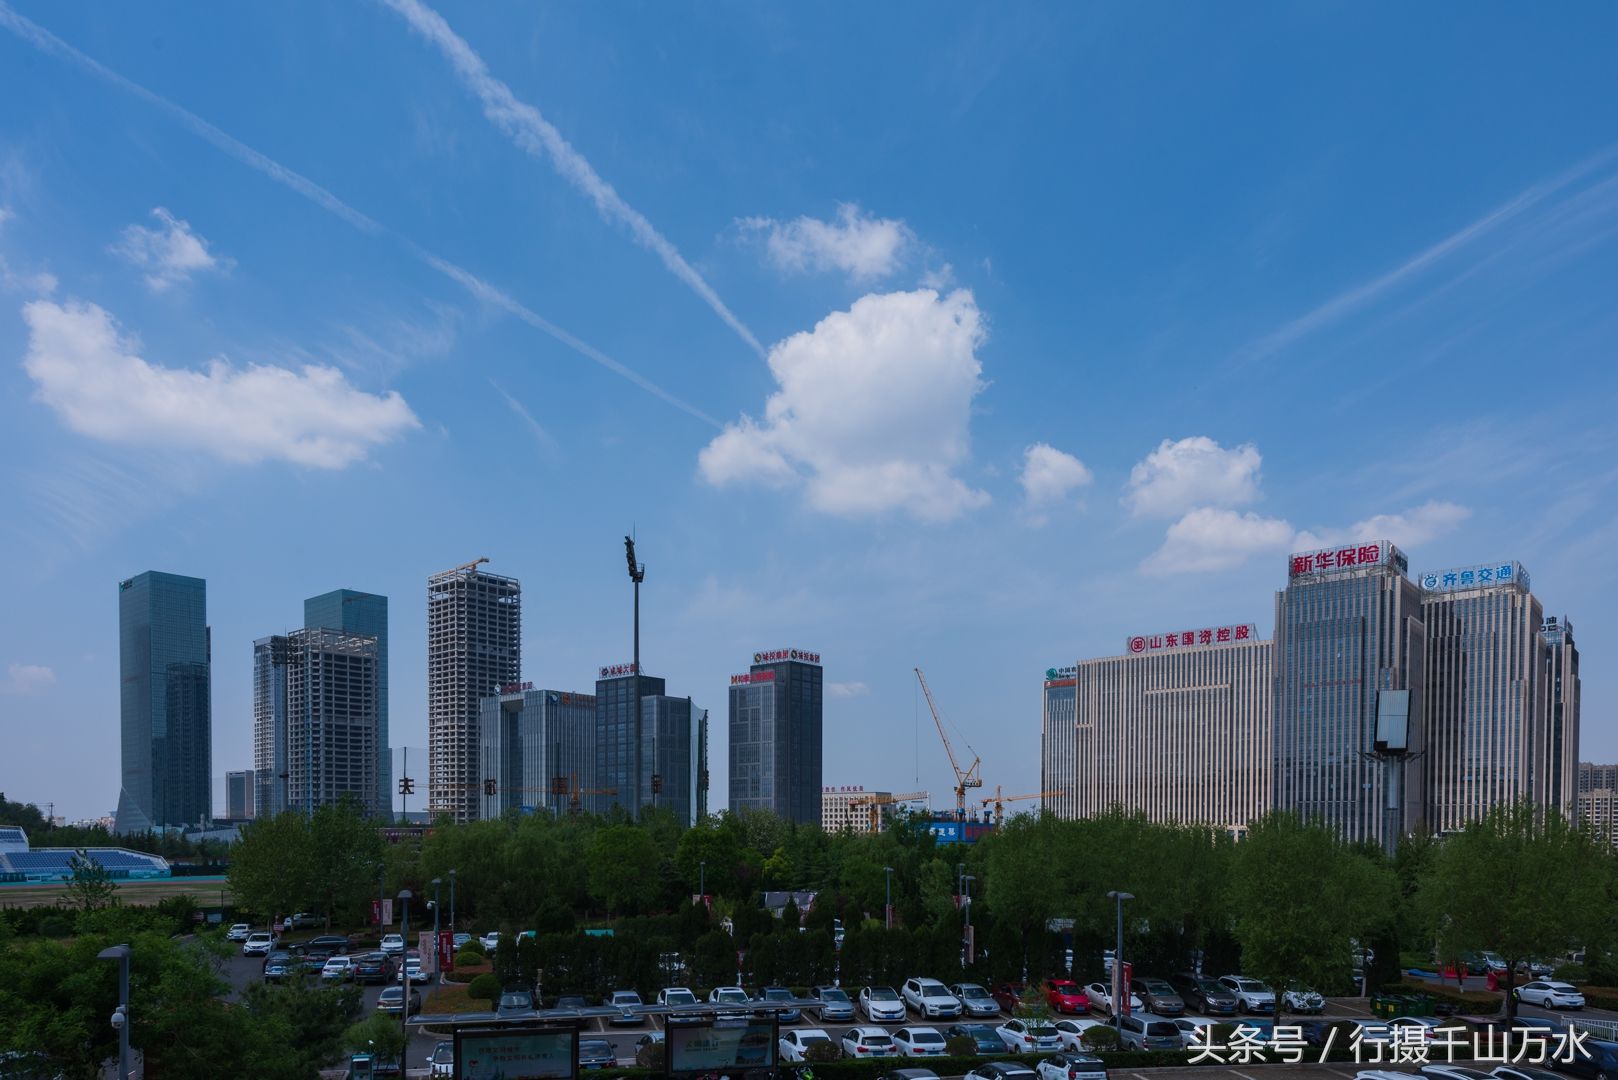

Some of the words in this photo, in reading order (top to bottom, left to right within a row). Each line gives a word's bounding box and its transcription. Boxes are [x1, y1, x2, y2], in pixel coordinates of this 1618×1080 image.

[1293, 544, 1380, 574] 新华保险
[1442, 565, 1513, 587] 齐鲁交通
[1149, 625, 1250, 649] 山东国资控股
